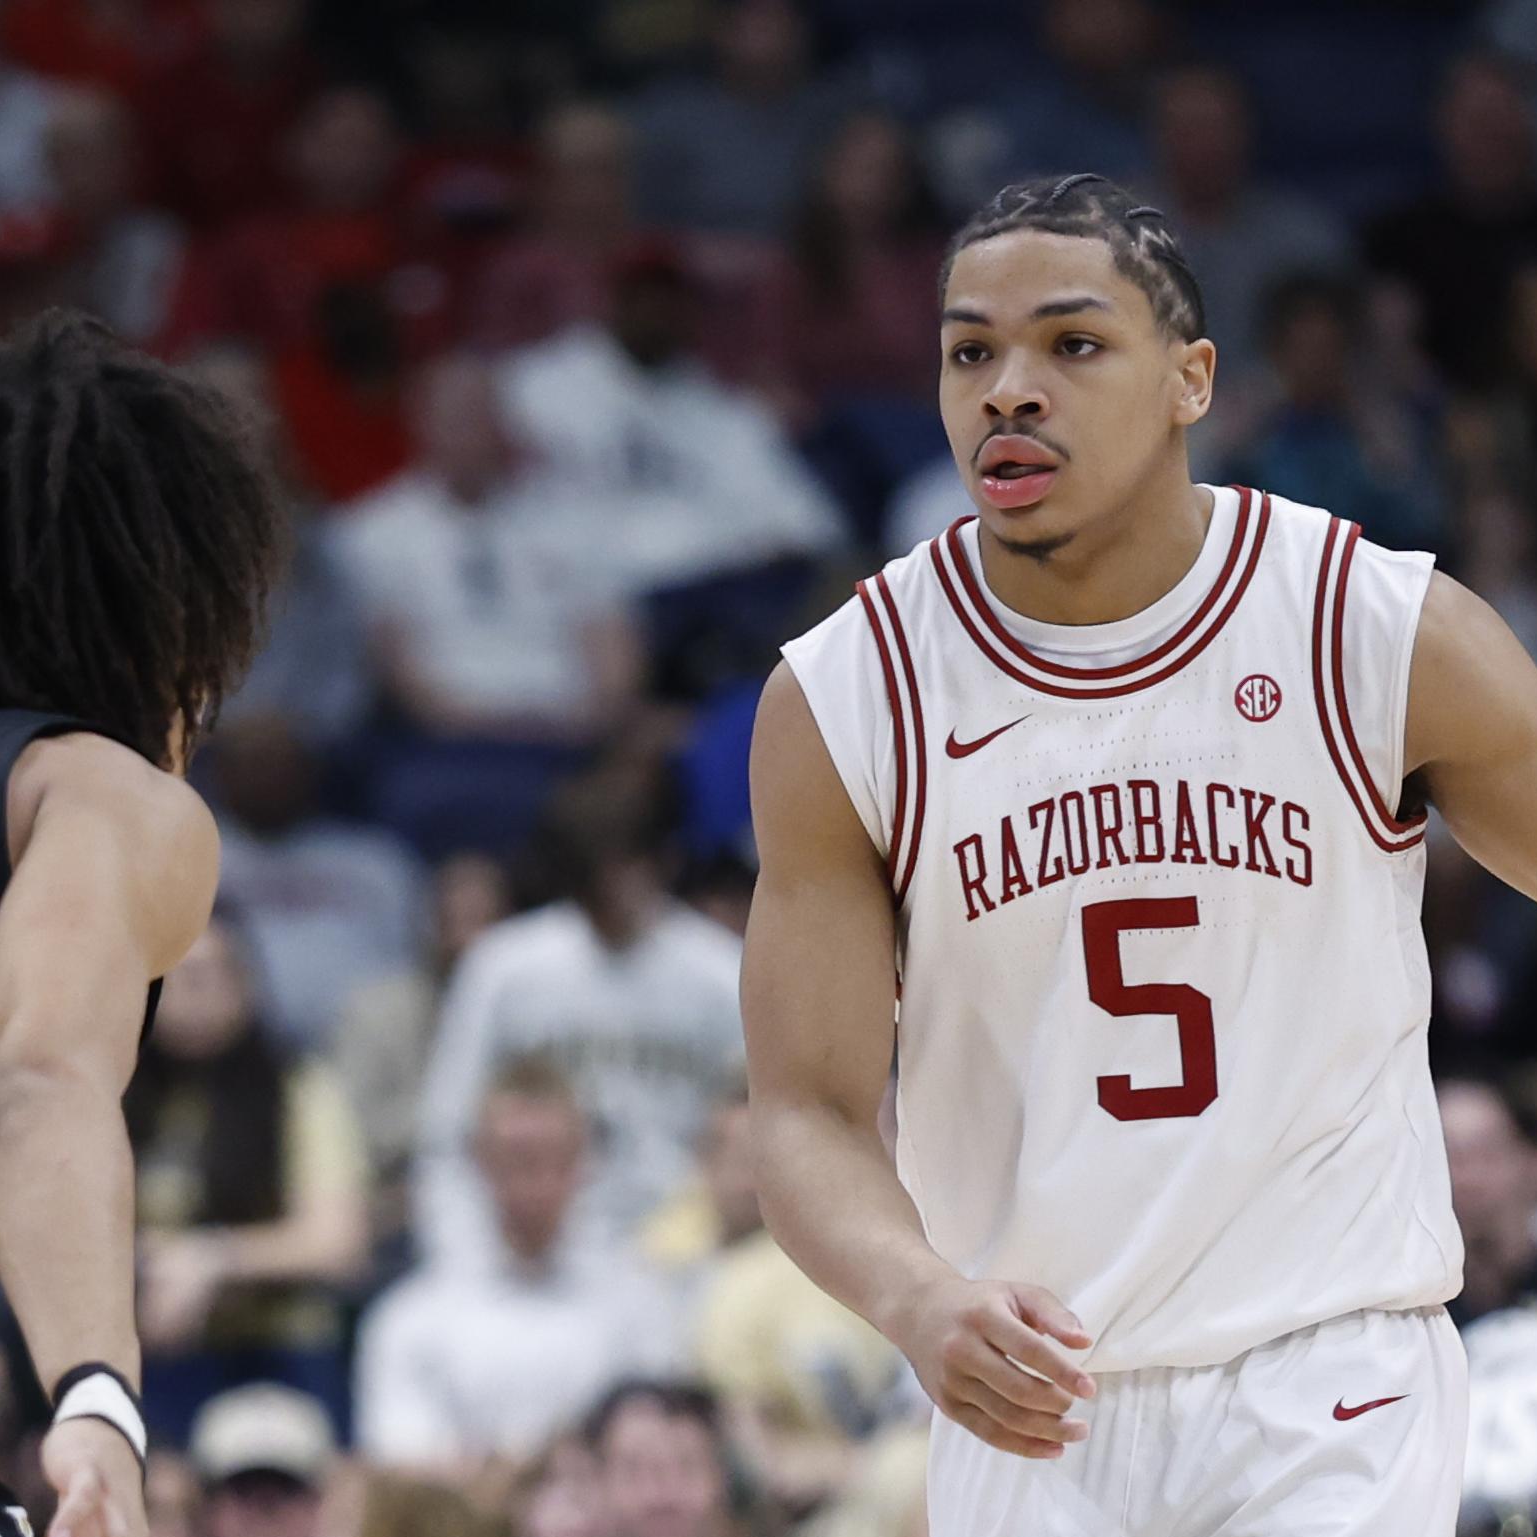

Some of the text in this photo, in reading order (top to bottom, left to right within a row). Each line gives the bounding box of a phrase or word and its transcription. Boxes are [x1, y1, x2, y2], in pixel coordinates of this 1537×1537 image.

[1237, 676, 1280, 720] SEC
[952, 779, 1313, 922] RAZORBACKS
[1081, 896, 1218, 1122] 5
